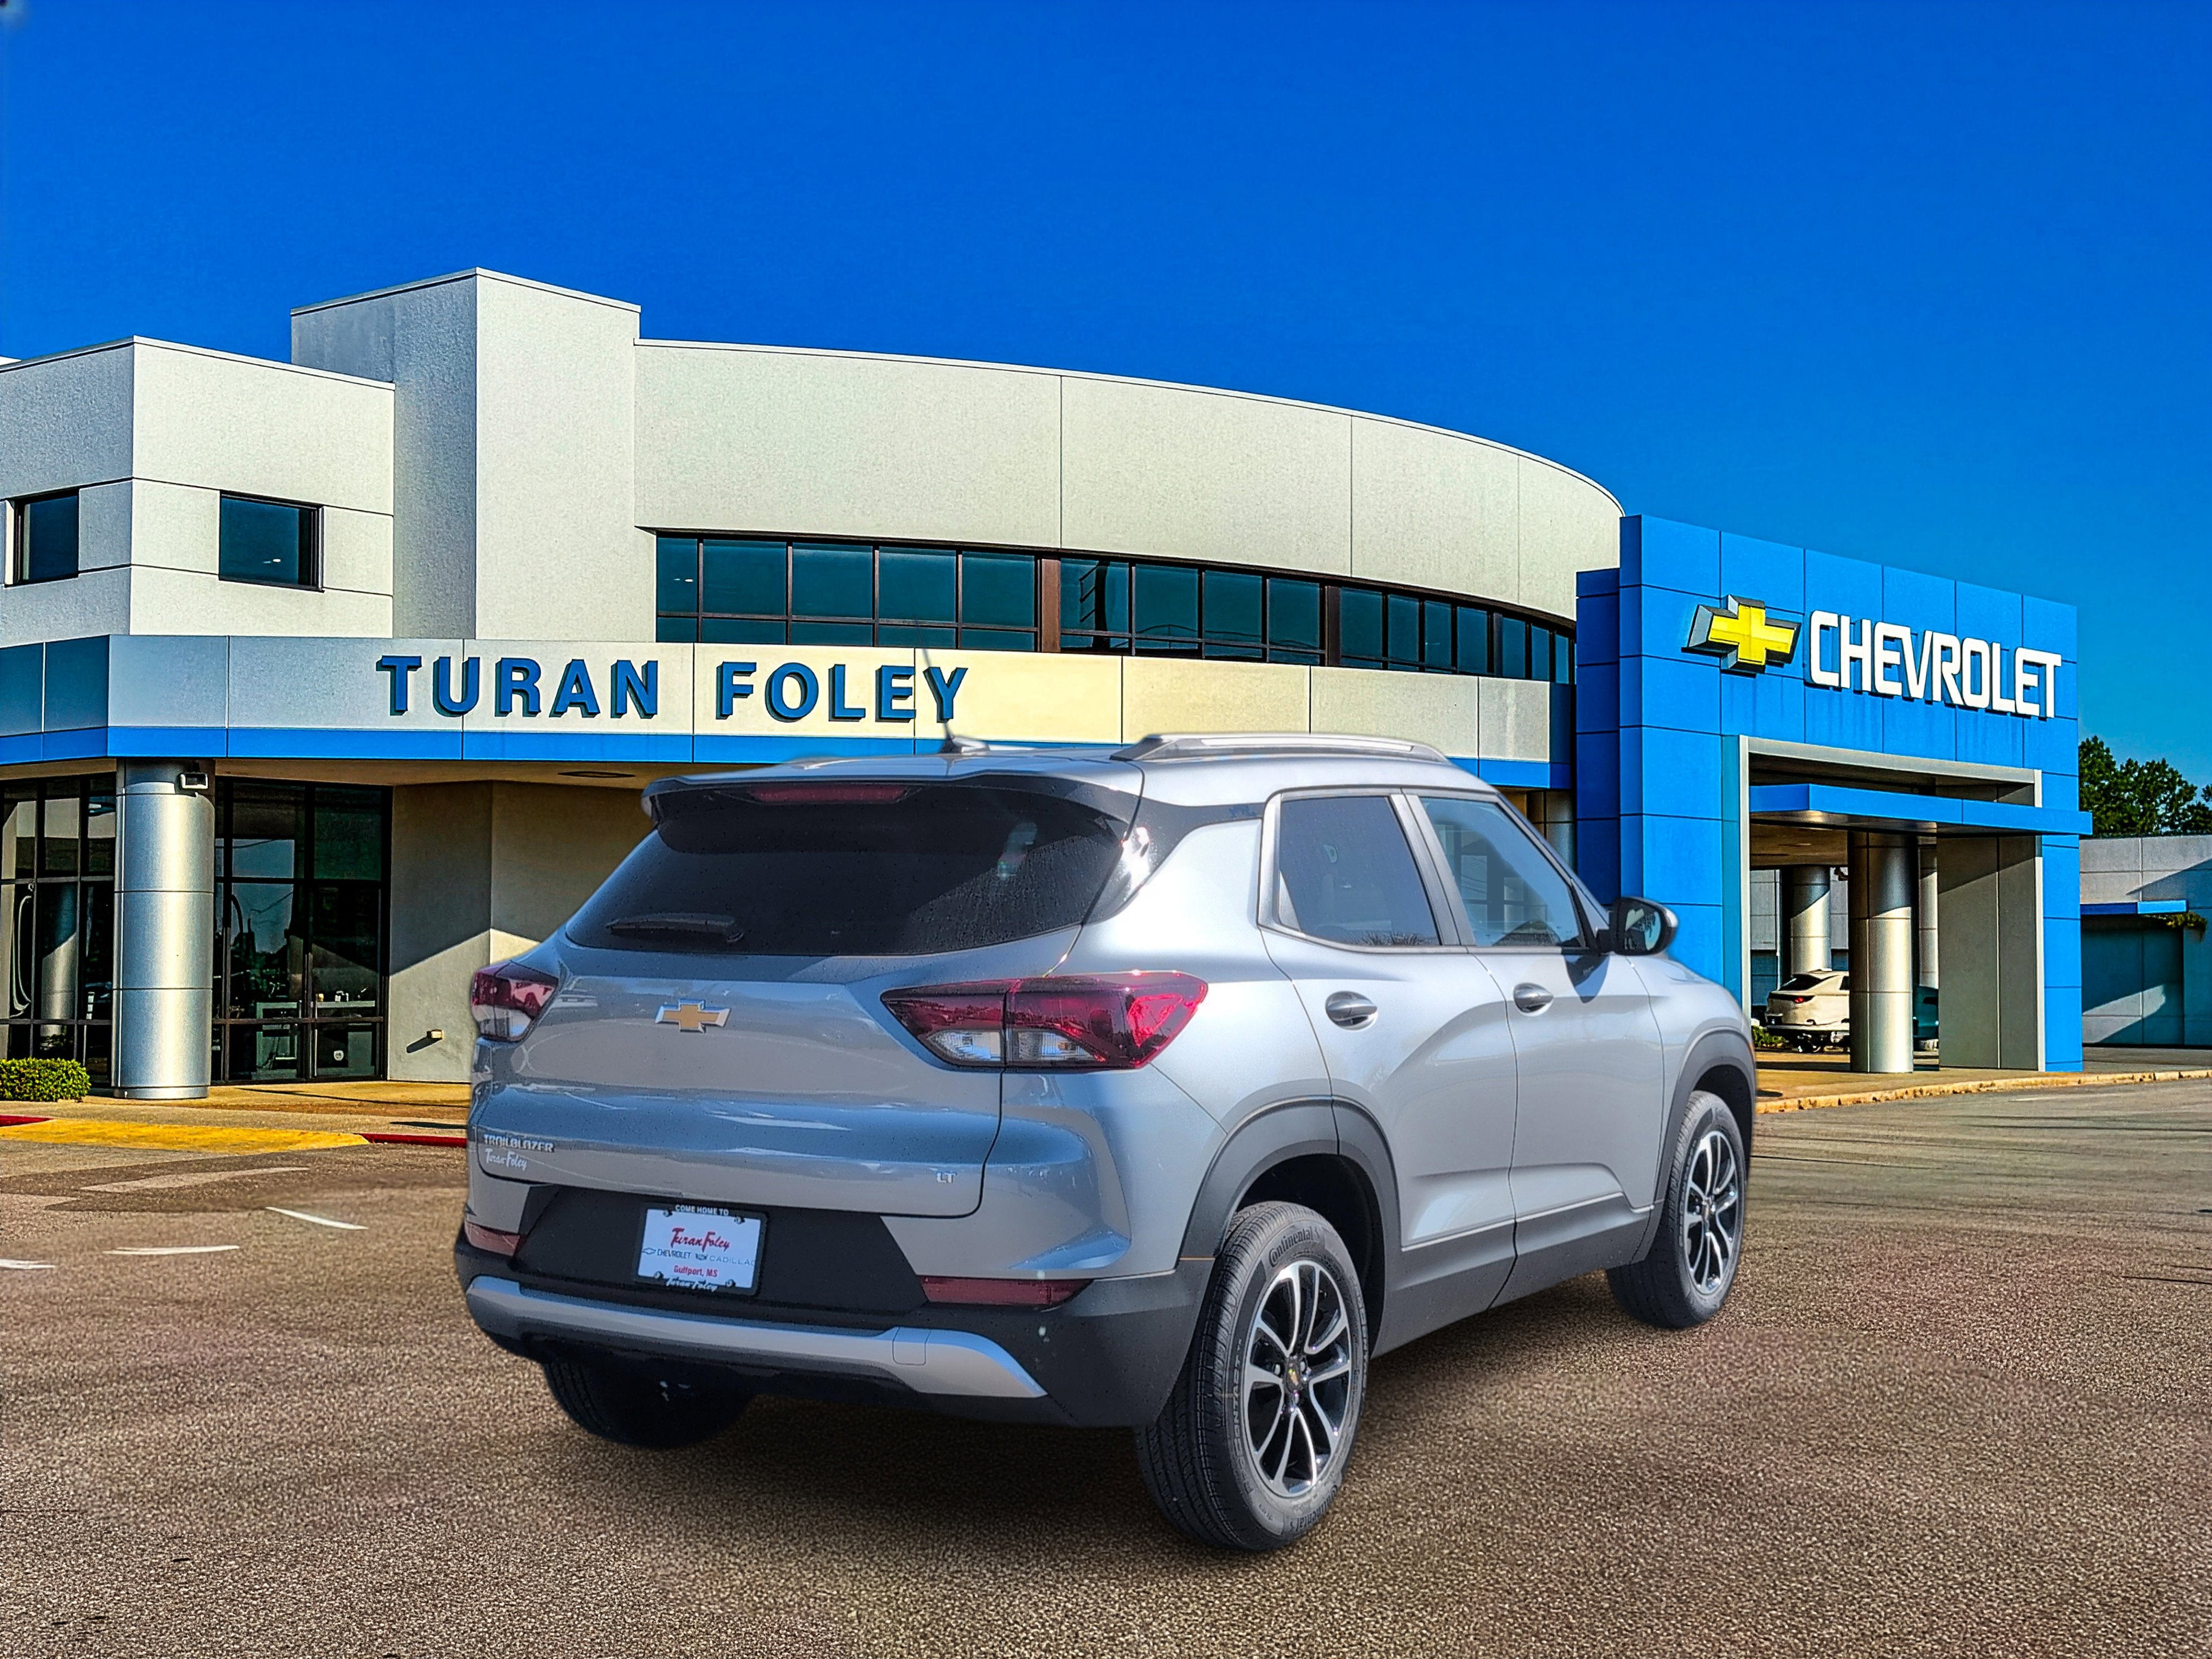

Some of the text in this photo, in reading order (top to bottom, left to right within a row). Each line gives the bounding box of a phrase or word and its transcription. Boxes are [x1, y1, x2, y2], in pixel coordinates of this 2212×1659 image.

[1809, 609, 2062, 718] CHEVROLET
[376, 655, 968, 723] TURAN FOLEY
[484, 1134, 555, 1153] TRAILBLAZER
[936, 1171, 957, 1184] LT
[675, 1204, 696, 1212] COME
[697, 1206, 717, 1214] HOME
[657, 1248, 691, 1258] CHEVROLET
[1269, 1226, 1314, 1268] Continental
[673, 1265, 718, 1277] Gulfport, MS
